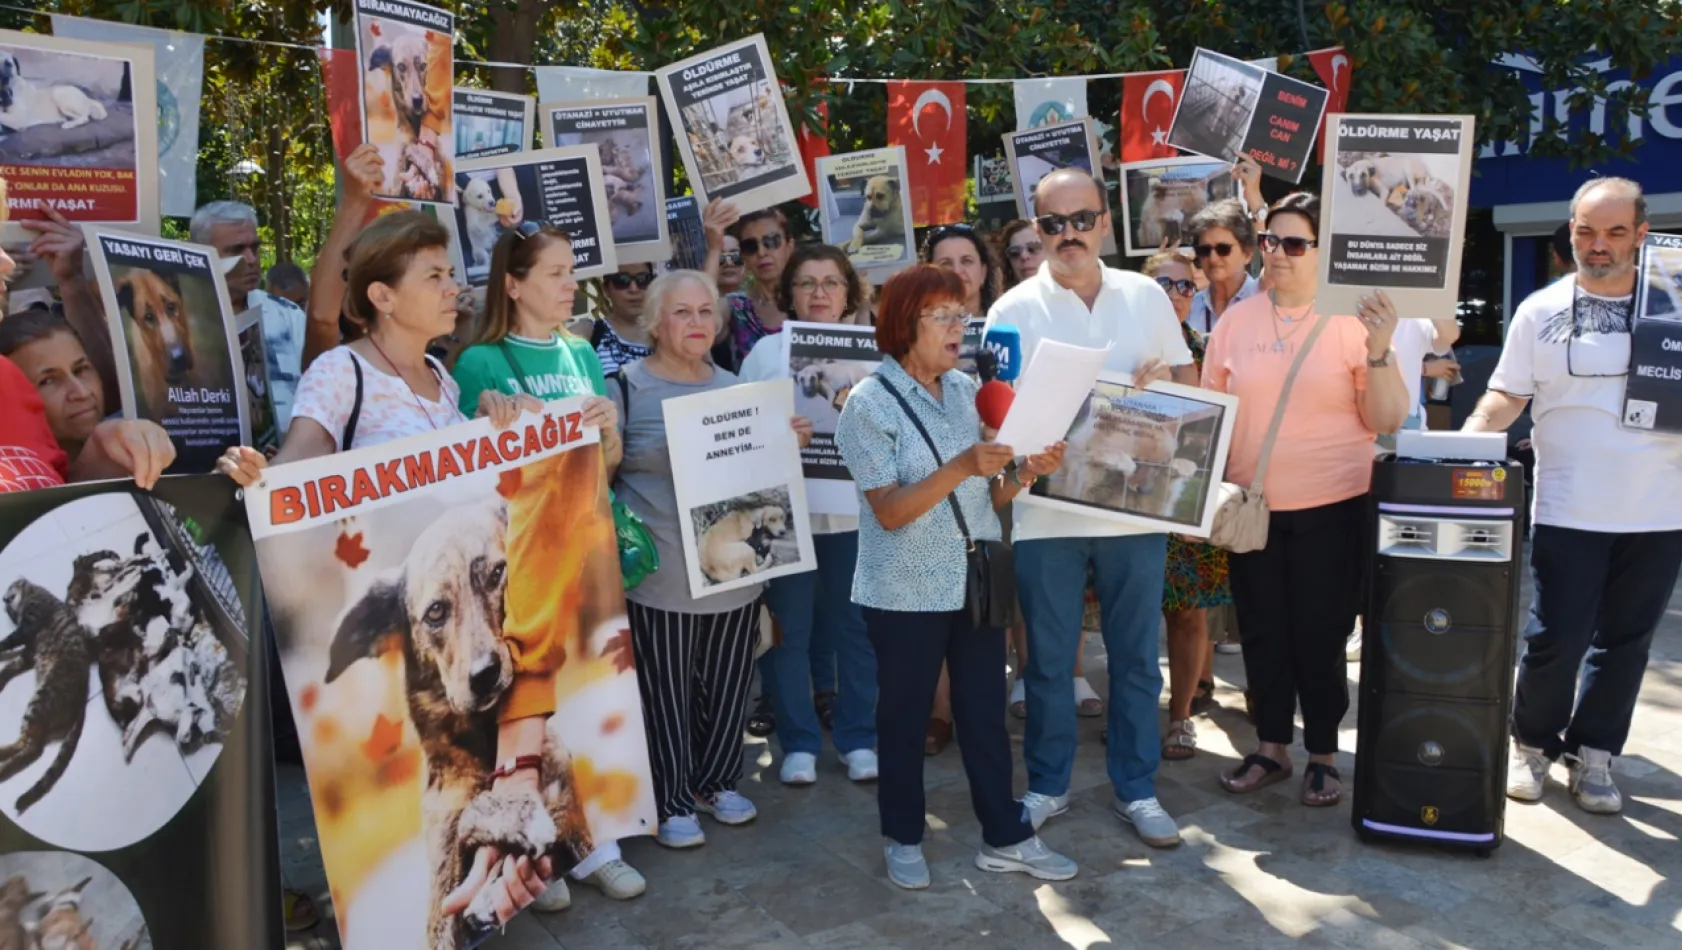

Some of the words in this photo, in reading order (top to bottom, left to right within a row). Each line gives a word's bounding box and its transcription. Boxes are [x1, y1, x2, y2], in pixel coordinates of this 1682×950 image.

[683, 52, 741, 81] ÖLDÜRME
[1270, 128, 1292, 142] CAN
[1339, 124, 1409, 138] ÖLDÜRME
[1413, 127, 1460, 142] YAŞAT
[19, 167, 49, 176] SENİN
[51, 168, 91, 178] EVLADIN
[117, 171, 133, 179] BAK
[15, 182, 49, 191] ONLAR
[52, 182, 65, 192] DA
[67, 183, 87, 192] ANA
[4, 198, 40, 209] RME
[48, 198, 96, 211] YAŞAT
[1347, 240, 1358, 248] BU
[105, 241, 151, 259] YASAYI
[154, 247, 183, 265] GERİ
[185, 253, 207, 268] ÇEK
[791, 333, 852, 347] ÖLDÜRME
[168, 387, 199, 402] Allah
[200, 387, 231, 403] Derki
[702, 408, 752, 426] ÖLDÜRME
[714, 430, 735, 442] BEN
[739, 426, 751, 436] DE
[270, 411, 583, 525] BIRAKMAYACAĞIZ
